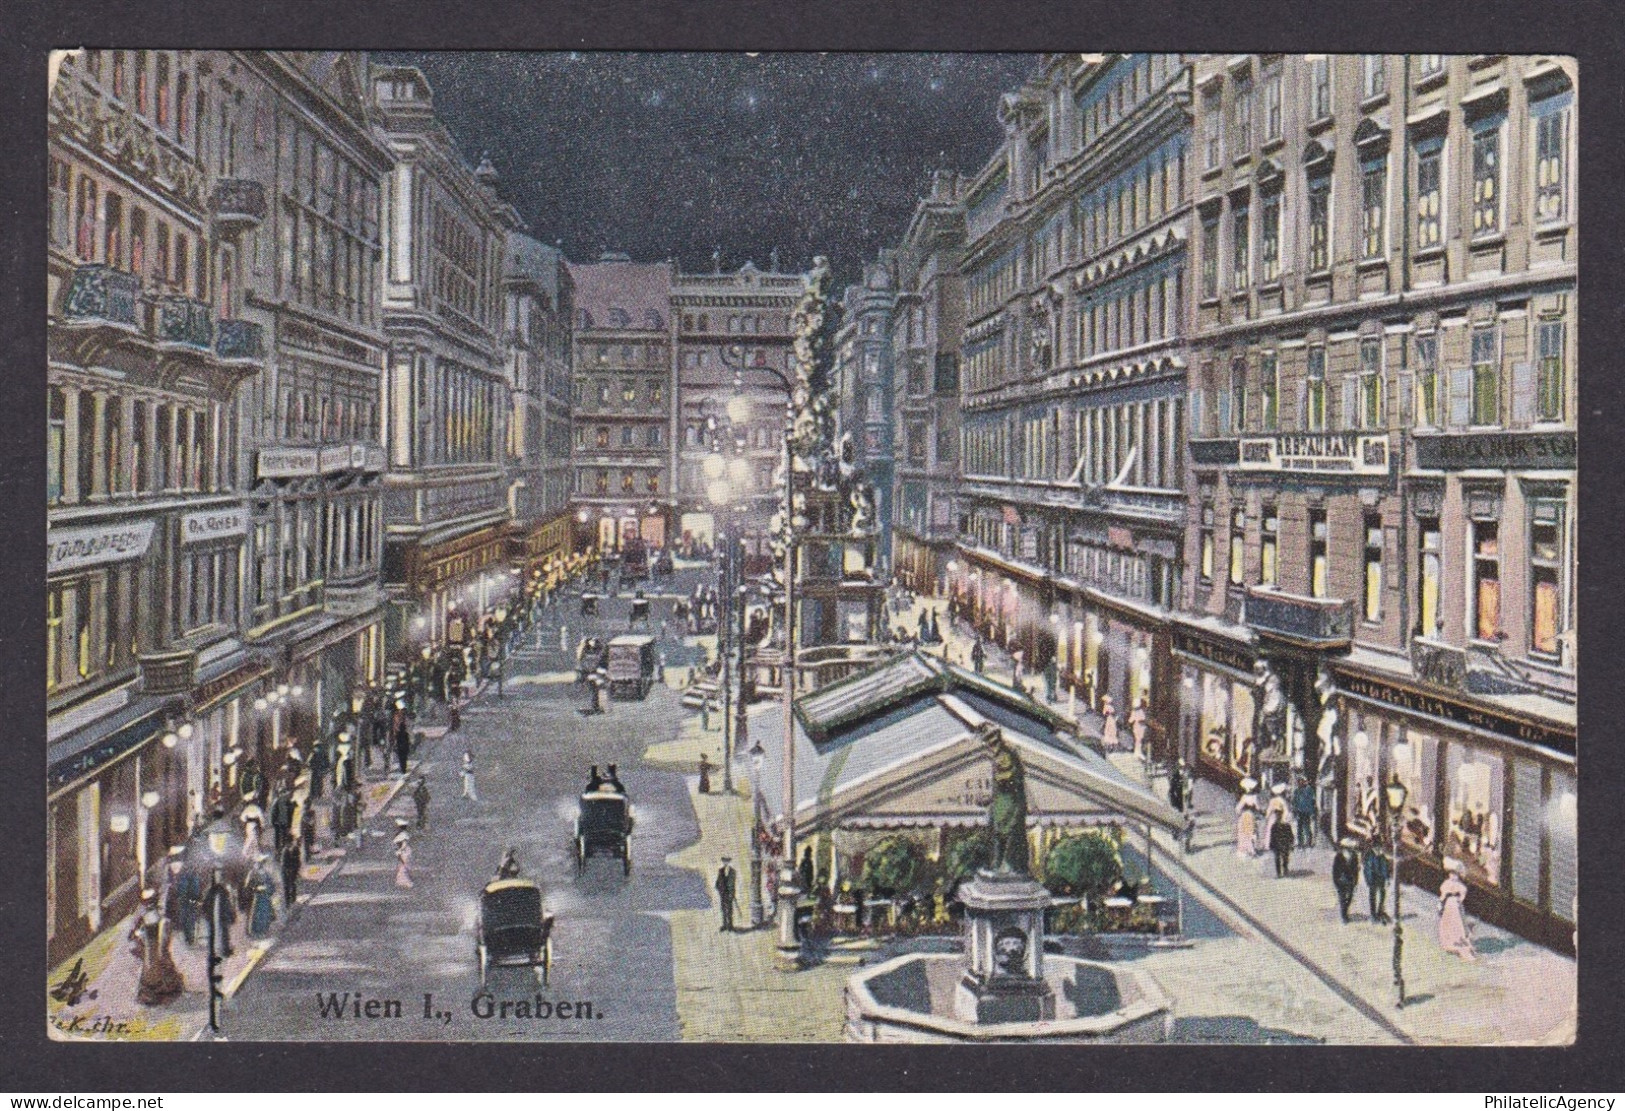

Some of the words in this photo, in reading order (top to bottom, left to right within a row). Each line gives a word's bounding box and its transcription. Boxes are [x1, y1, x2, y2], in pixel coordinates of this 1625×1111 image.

[315, 993, 402, 1019] Wien
[422, 993, 452, 1025] I.,
[470, 991, 604, 1020] Graben.
